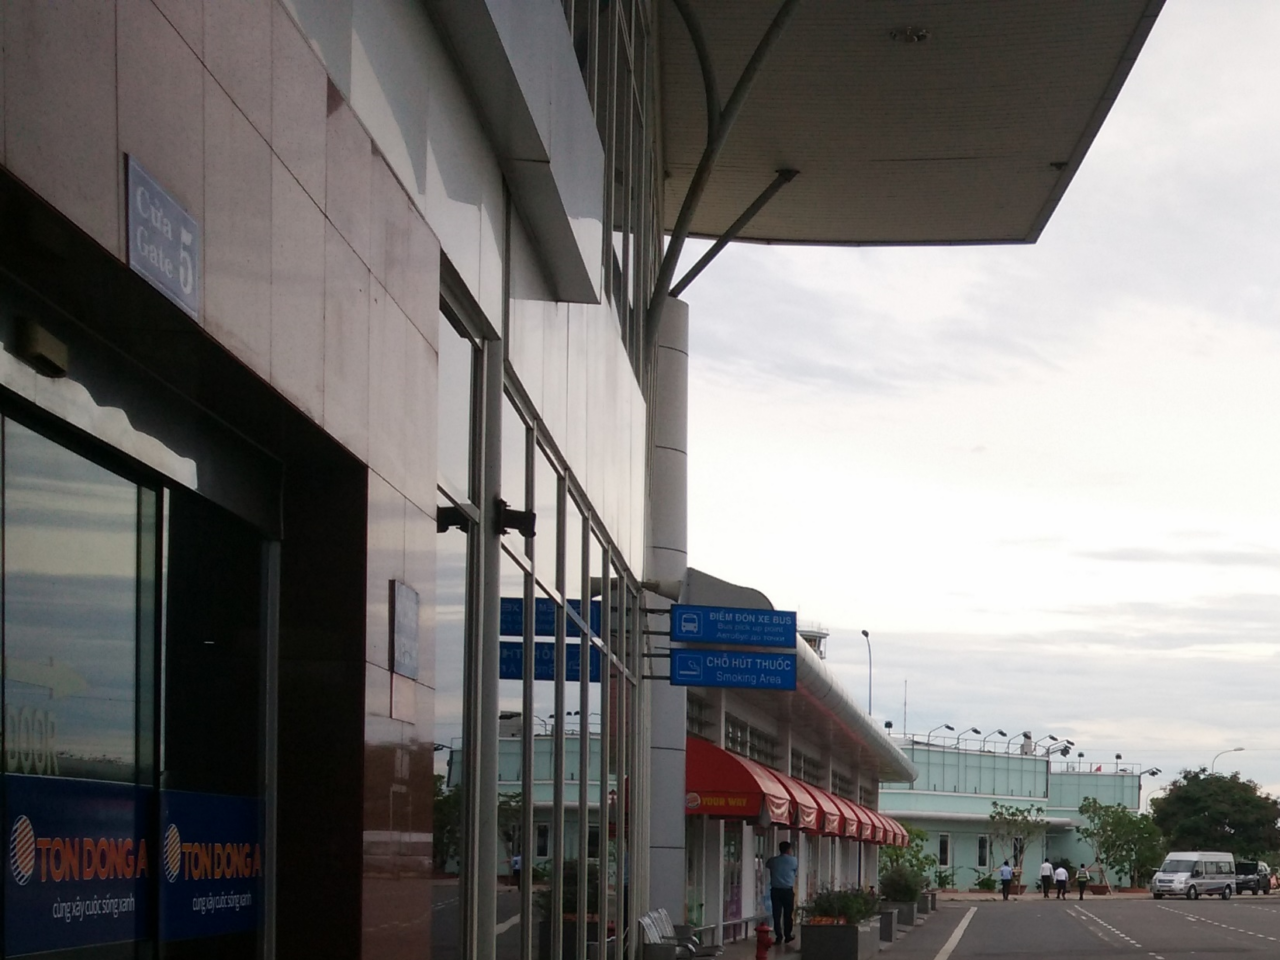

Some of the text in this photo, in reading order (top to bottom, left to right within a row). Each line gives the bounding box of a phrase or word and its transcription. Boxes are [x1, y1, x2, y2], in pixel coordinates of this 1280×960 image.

[136, 186, 173, 241] Cửa
[136, 226, 173, 279] Gate
[179, 226, 193, 295] 5
[709, 609, 792, 625] ĐIỂM ĐÓN XE BUS
[718, 622, 732, 630] Bus
[734, 623, 750, 631] pick
[716, 671, 782, 685] Smoking Area
[731, 656, 752, 669] HÚT
[755, 656, 791, 671] THUỐC
[701, 797, 725, 807] YOUR
[728, 797, 747, 807] WAY
[36, 837, 149, 882] TON DONG A
[181, 842, 212, 880] TON
[214, 842, 252, 879] DONG
[52, 893, 135, 922] cùng xây cuộc sống xanh
